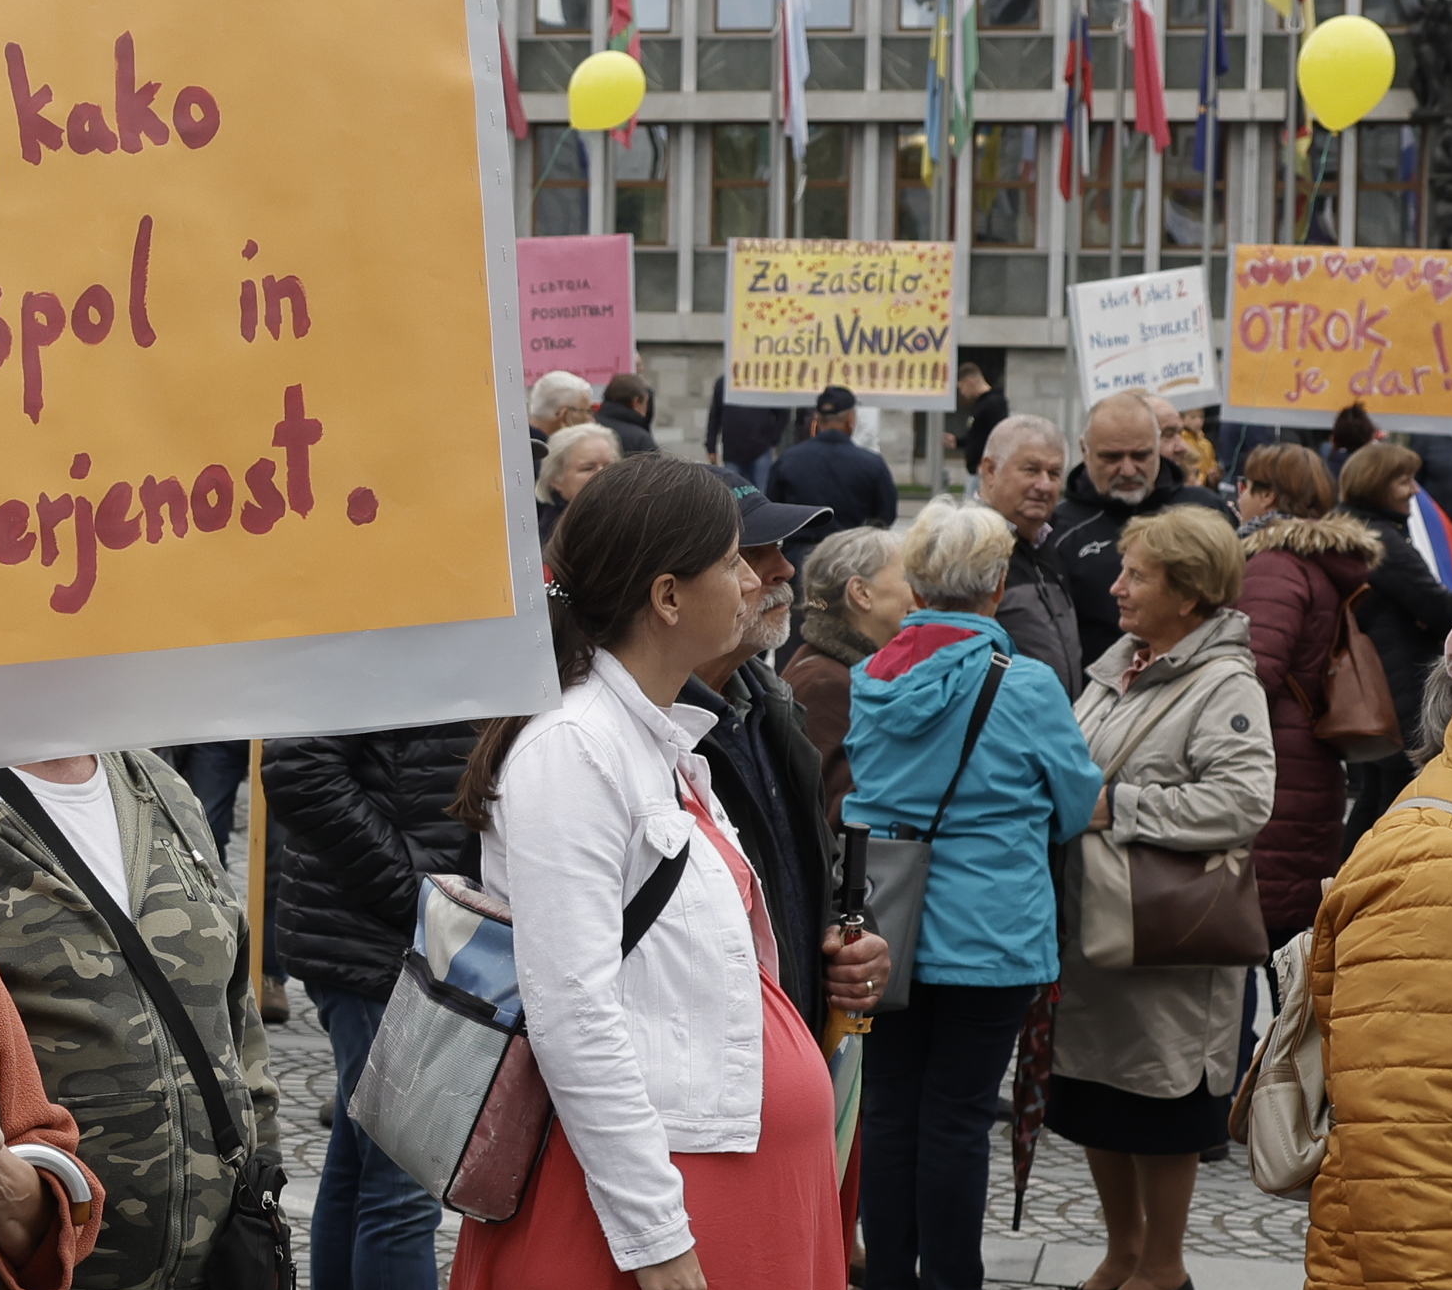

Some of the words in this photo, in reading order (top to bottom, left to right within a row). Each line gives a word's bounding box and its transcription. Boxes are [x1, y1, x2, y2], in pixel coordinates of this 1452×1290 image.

[240, 239, 313, 346] in
[748, 261, 789, 293] Za
[808, 259, 923, 295] zaščito
[754, 321, 831, 356] naših
[834, 313, 950, 356] VNUKOV
[1239, 298, 1392, 354] OTROK
[1284, 359, 1329, 403] je
